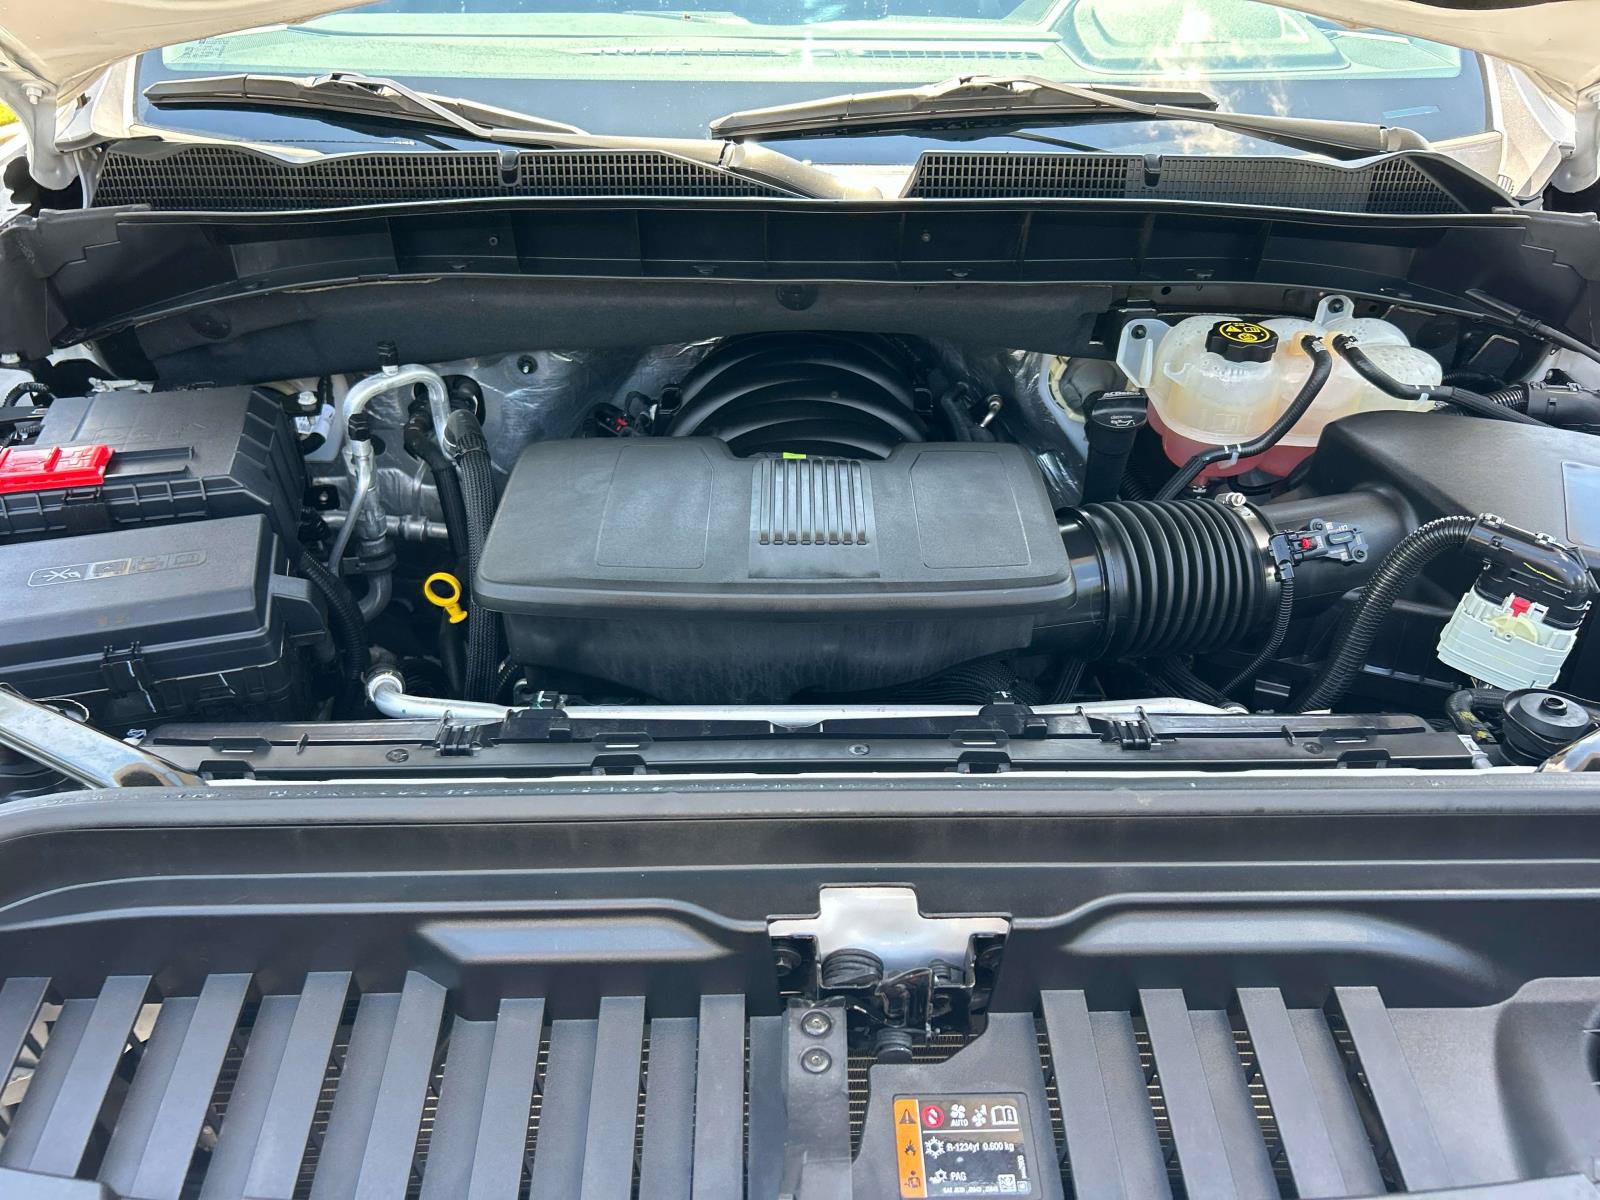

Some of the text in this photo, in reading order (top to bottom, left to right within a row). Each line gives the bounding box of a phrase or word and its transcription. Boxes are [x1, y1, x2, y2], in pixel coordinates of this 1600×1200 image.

[950, 1119, 968, 1127] AUTO
[1005, 1142, 1014, 1152] kg
[951, 1172, 967, 1181] PAG
